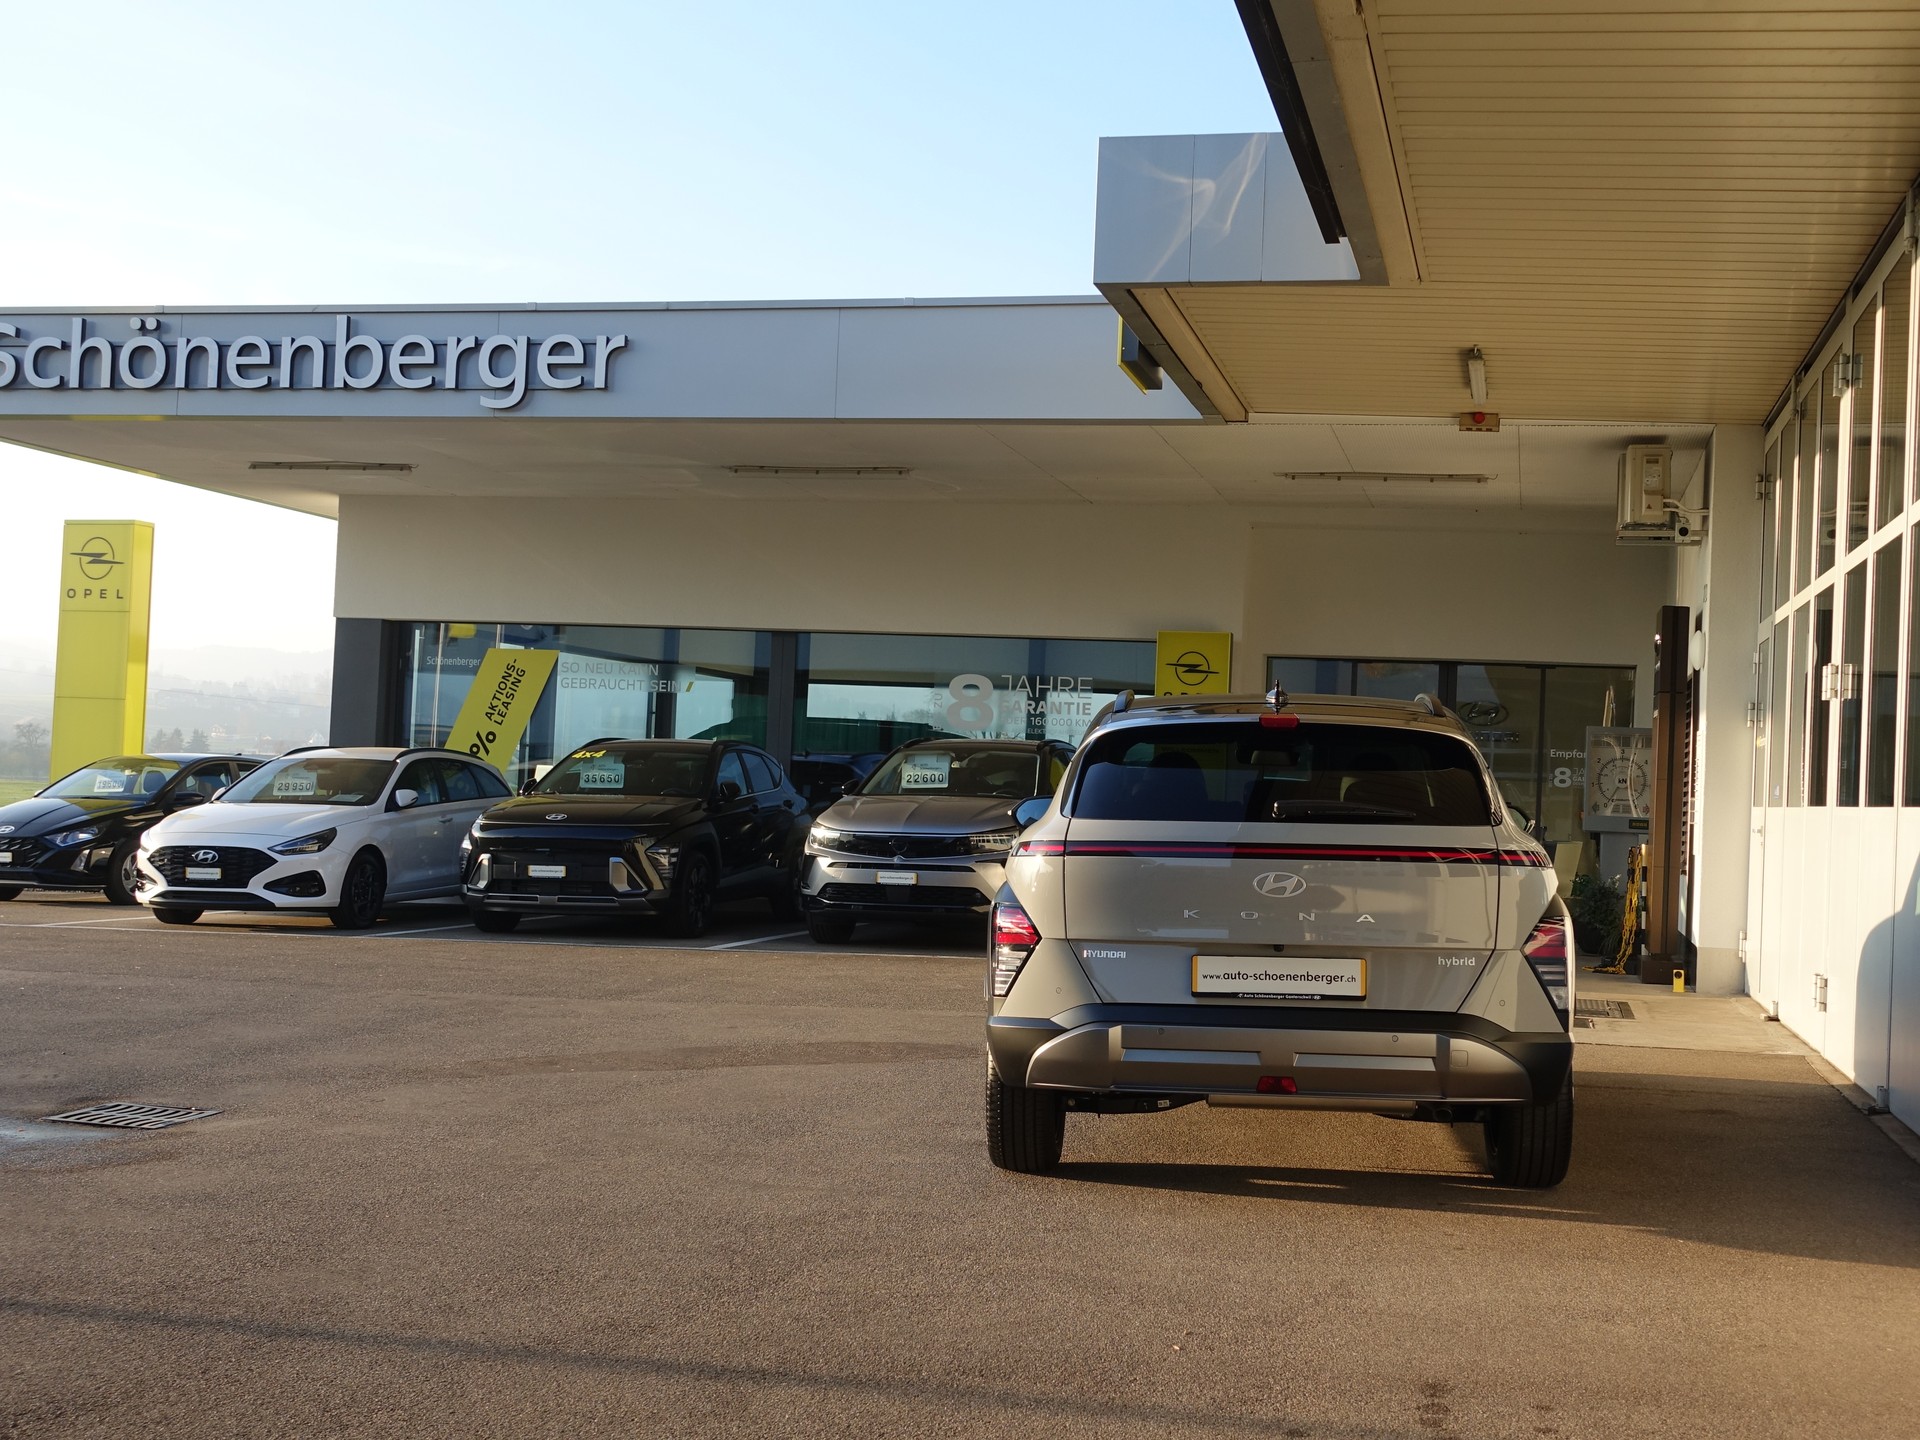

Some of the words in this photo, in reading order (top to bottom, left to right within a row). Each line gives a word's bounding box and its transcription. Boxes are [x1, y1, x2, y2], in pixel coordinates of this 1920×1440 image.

[66, 588, 124, 599] OPEL
[560, 661, 580, 674] SO
[585, 662, 614, 675] NEU
[484, 658, 517, 722] AKTIONS-
[560, 677, 646, 691] GEBRAUCHT
[649, 680, 681, 692] SEIN
[1000, 674, 1093, 699] JAHRE
[493, 667, 527, 726] LEASING
[947, 673, 994, 730] 8
[584, 774, 620, 783] 35650
[906, 773, 944, 783] 22600
[1553, 767, 1572, 788] 8
[1184, 909, 1375, 923] KONA
[1083, 949, 1126, 959] HYUNDAI
[1437, 956, 1475, 967] hybrid
[1202, 970, 1356, 985] www.auto-schoenenberger.ch
